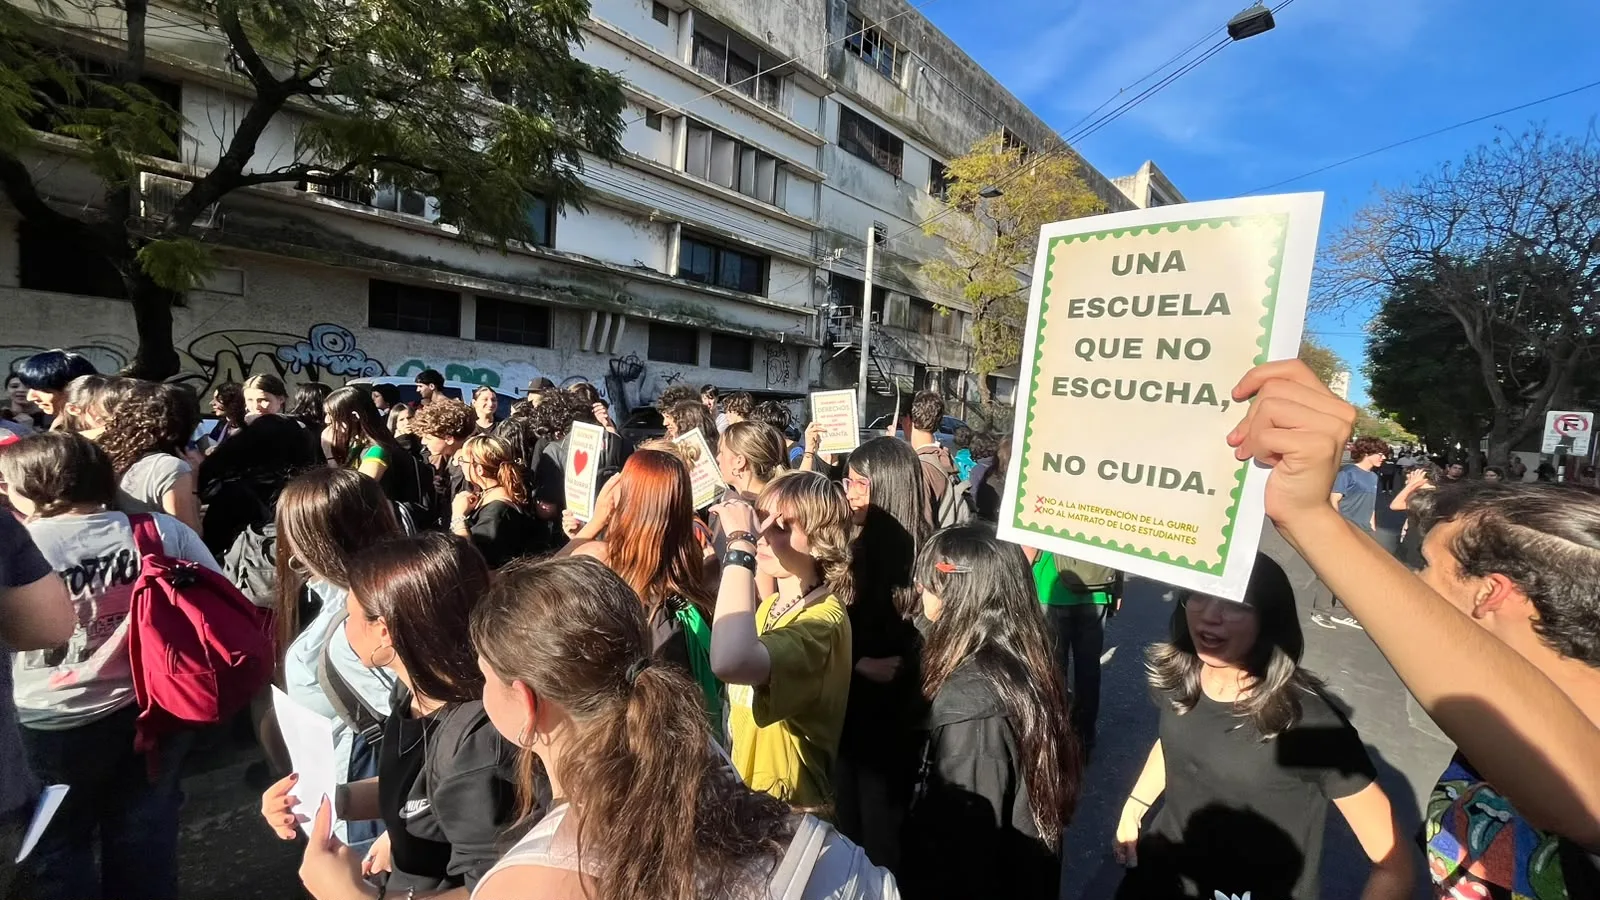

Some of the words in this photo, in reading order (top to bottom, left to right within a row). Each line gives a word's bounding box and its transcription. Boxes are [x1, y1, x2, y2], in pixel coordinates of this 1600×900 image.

[1111, 249, 1187, 276] UNA
[1067, 292, 1231, 319] ESCUELA
[1074, 337, 1144, 362] QUE
[1155, 337, 1212, 361] NO
[1051, 376, 1230, 413] ESCUCHA,
[1042, 452, 1086, 476] NO
[1097, 459, 1216, 496] CUIDA.
[1042, 507, 1055, 516] NO
[1056, 509, 1066, 518] AL
[1067, 512, 1105, 526] MATRATO
[1106, 519, 1119, 529] DE
[1119, 522, 1137, 533] LOS
[1137, 525, 1197, 545] ESTUDIANTES
[1044, 497, 1057, 506] NO
[1058, 499, 1065, 507] A
[1066, 501, 1076, 509] LA
[1077, 503, 1139, 522] INTERVENCIÓN
[1139, 514, 1152, 524] DE
[1153, 517, 1164, 527] LA
[1166, 520, 1199, 534] GURRU
[405, 798, 428, 811] NIKE
